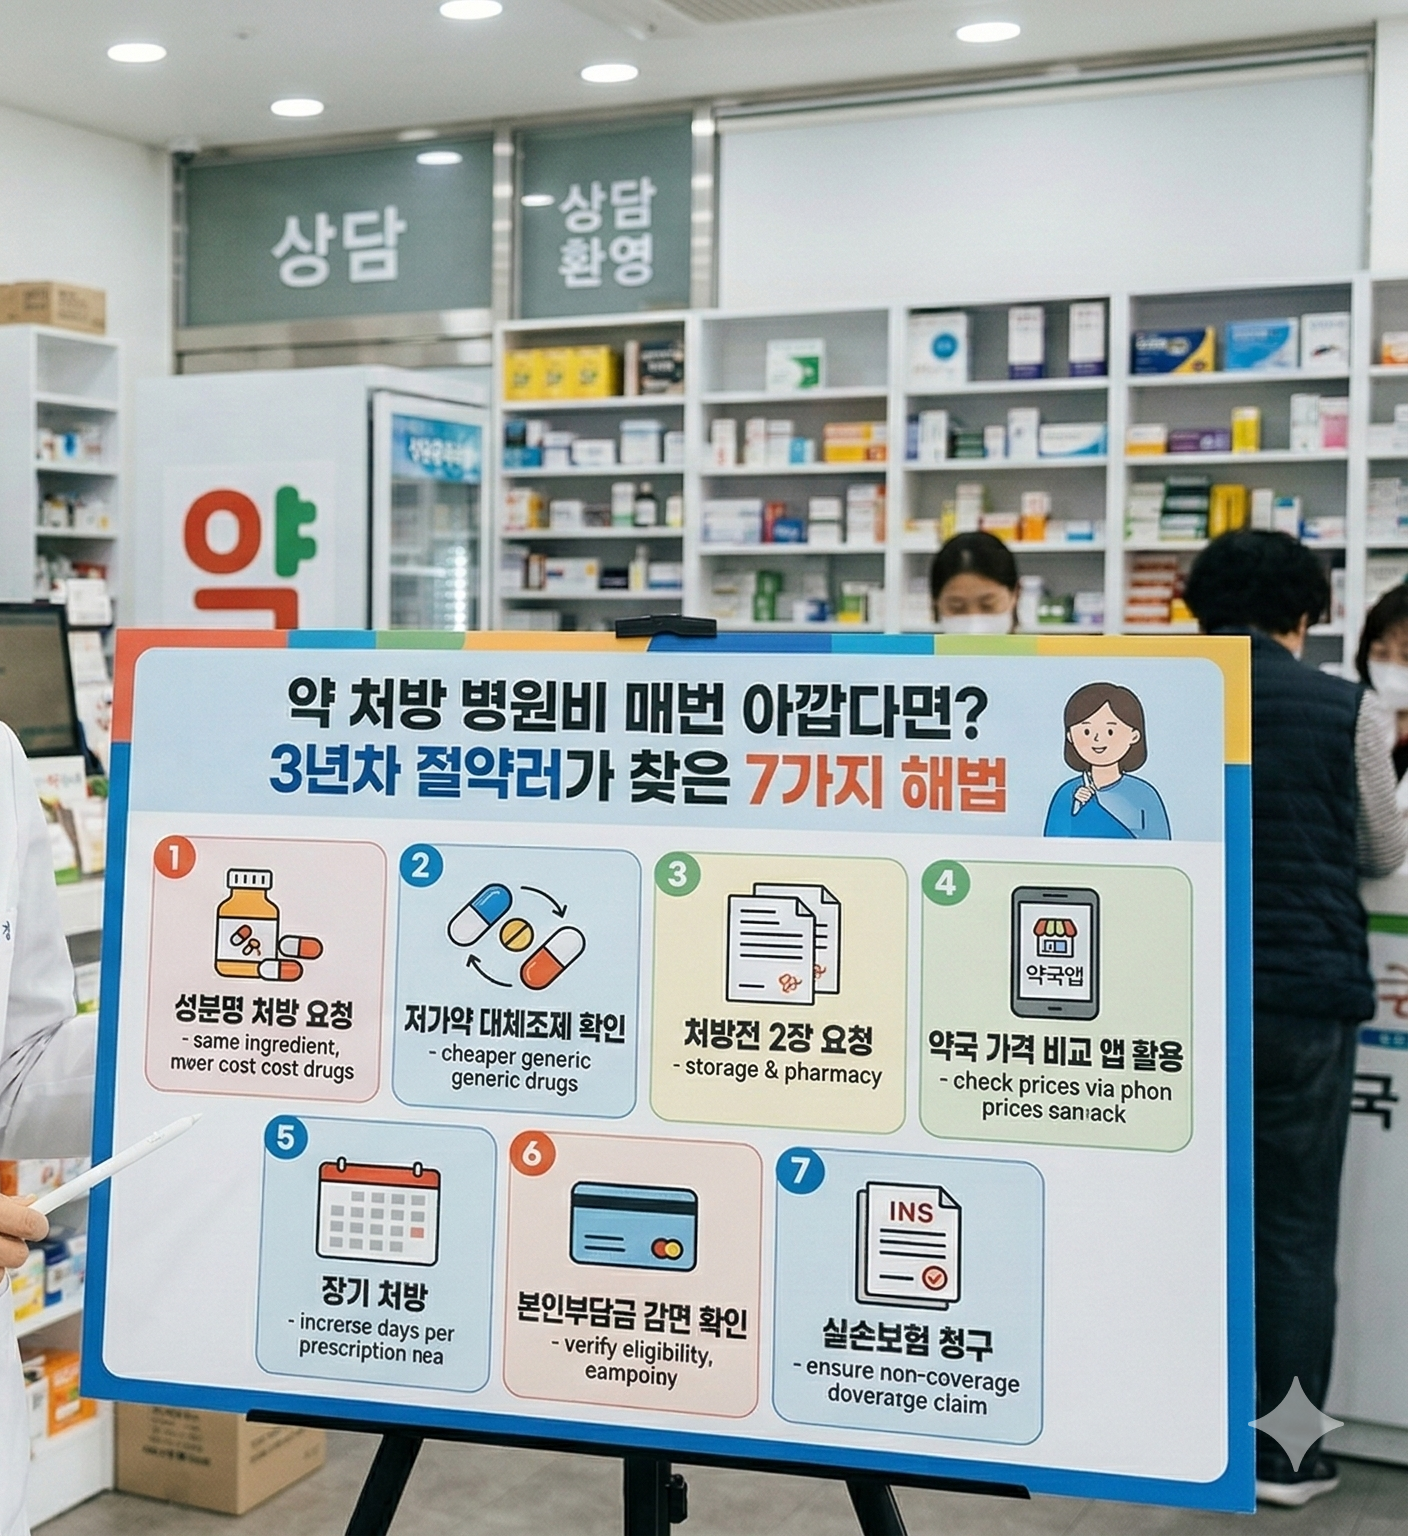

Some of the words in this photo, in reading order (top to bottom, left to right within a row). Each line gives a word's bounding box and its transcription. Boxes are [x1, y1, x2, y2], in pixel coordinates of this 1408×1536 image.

[558, 176, 657, 234] 상담
[272, 205, 408, 288] 상담
[558, 232, 653, 289] 환영
[184, 485, 318, 629] 약
[288, 676, 336, 729] 약
[349, 677, 448, 731] 처방
[462, 679, 607, 733] 병원비
[625, 682, 724, 736] 매번
[742, 683, 988, 740] 아깝다면?
[269, 743, 402, 797] 3년차
[416, 745, 615, 802] 절약러가
[630, 748, 731, 806] 찾은
[745, 753, 883, 810] 7가지
[901, 754, 1007, 813] 해법
[168, 846, 180, 869] 1
[411, 851, 430, 878] 2
[667, 860, 688, 888] 3
[934, 869, 957, 896] 4
[1025, 964, 1084, 987] 약국앱
[174, 993, 244, 1025] 성분명
[251, 996, 300, 1028] 처방
[305, 999, 353, 1030] 요청
[404, 1004, 474, 1037] 저가약
[479, 1008, 572, 1041] 대체조제
[578, 1011, 626, 1044] 확인
[193, 1034, 240, 1051] same
[245, 1033, 340, 1059] ingredient,
[684, 1017, 760, 1051] 처방전
[768, 1021, 814, 1053] 2장
[820, 1024, 873, 1057] 요청
[928, 1029, 979, 1063] 약국
[986, 1033, 1035, 1066] 가격
[1043, 1035, 1093, 1067] 비교
[1099, 1038, 1125, 1070] 앱
[1131, 1038, 1184, 1073] 활용
[218, 1057, 257, 1075] cost
[261, 1060, 299, 1077] cost
[303, 1059, 355, 1085] drugs
[441, 1042, 517, 1069] cheaper
[521, 1050, 592, 1072] generic
[451, 1069, 521, 1091] generic
[525, 1071, 579, 1097] drugs
[685, 1058, 759, 1083] storage
[764, 1059, 779, 1080] &
[784, 1061, 883, 1090] pharmacy
[953, 1070, 1014, 1093] check
[1019, 1077, 1081, 1102] prices
[1085, 1077, 1115, 1098] via
[1121, 1079, 1172, 1104] phon
[982, 1099, 1045, 1125] prices
[276, 1123, 295, 1151] 5
[522, 1140, 542, 1167] 6
[790, 1156, 811, 1184] 7
[890, 1200, 934, 1224] INS
[322, 1275, 369, 1308] 장기
[377, 1279, 429, 1313] 처방
[517, 1291, 637, 1331] 본인부담금
[643, 1301, 691, 1335] 감면
[698, 1305, 747, 1340] 확인
[377, 1318, 420, 1346] days
[424, 1326, 455, 1345] per
[822, 1317, 929, 1357] 실손보험
[939, 1325, 994, 1363] 청구
[299, 1339, 407, 1364] prescription
[412, 1349, 444, 1366] nea
[564, 1336, 618, 1361] verify
[622, 1339, 713, 1370] eligibility,
[806, 1360, 875, 1380] ensure
[880, 1366, 1020, 1399] non-coverage
[933, 1392, 988, 1415] claim
